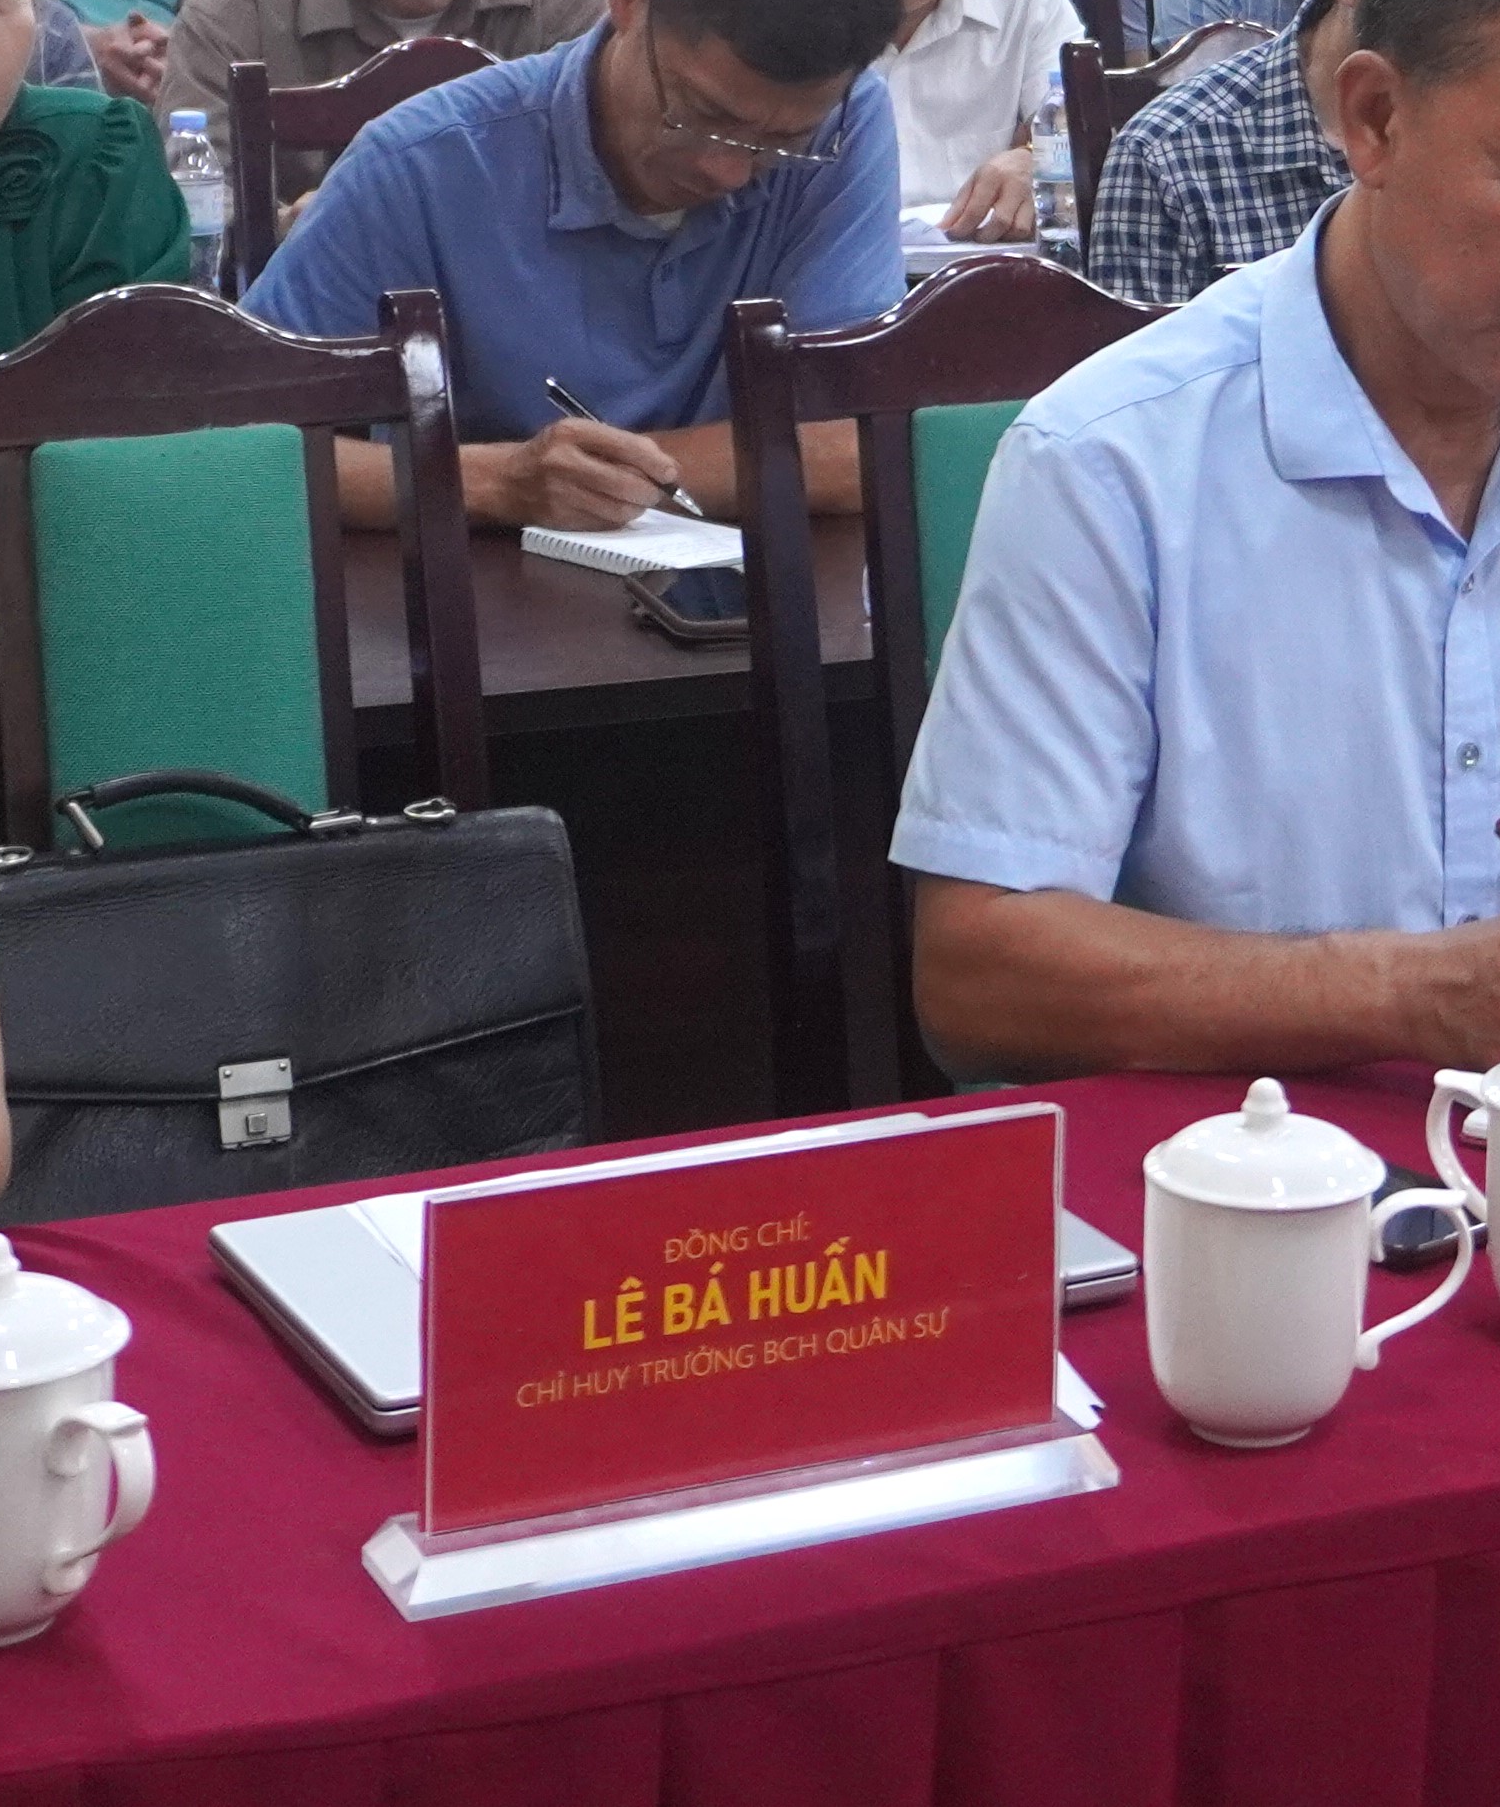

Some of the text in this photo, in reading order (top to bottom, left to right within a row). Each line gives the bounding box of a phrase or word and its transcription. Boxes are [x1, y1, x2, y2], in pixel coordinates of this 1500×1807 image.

[663, 1210, 811, 1264] ĐỒNG CHÍ:
[582, 1236, 889, 1350] LÊ BÁ HUẤN
[516, 1306, 950, 1409] CHỈ HUY TRƯỞNG BCH QUÂN SỰ
